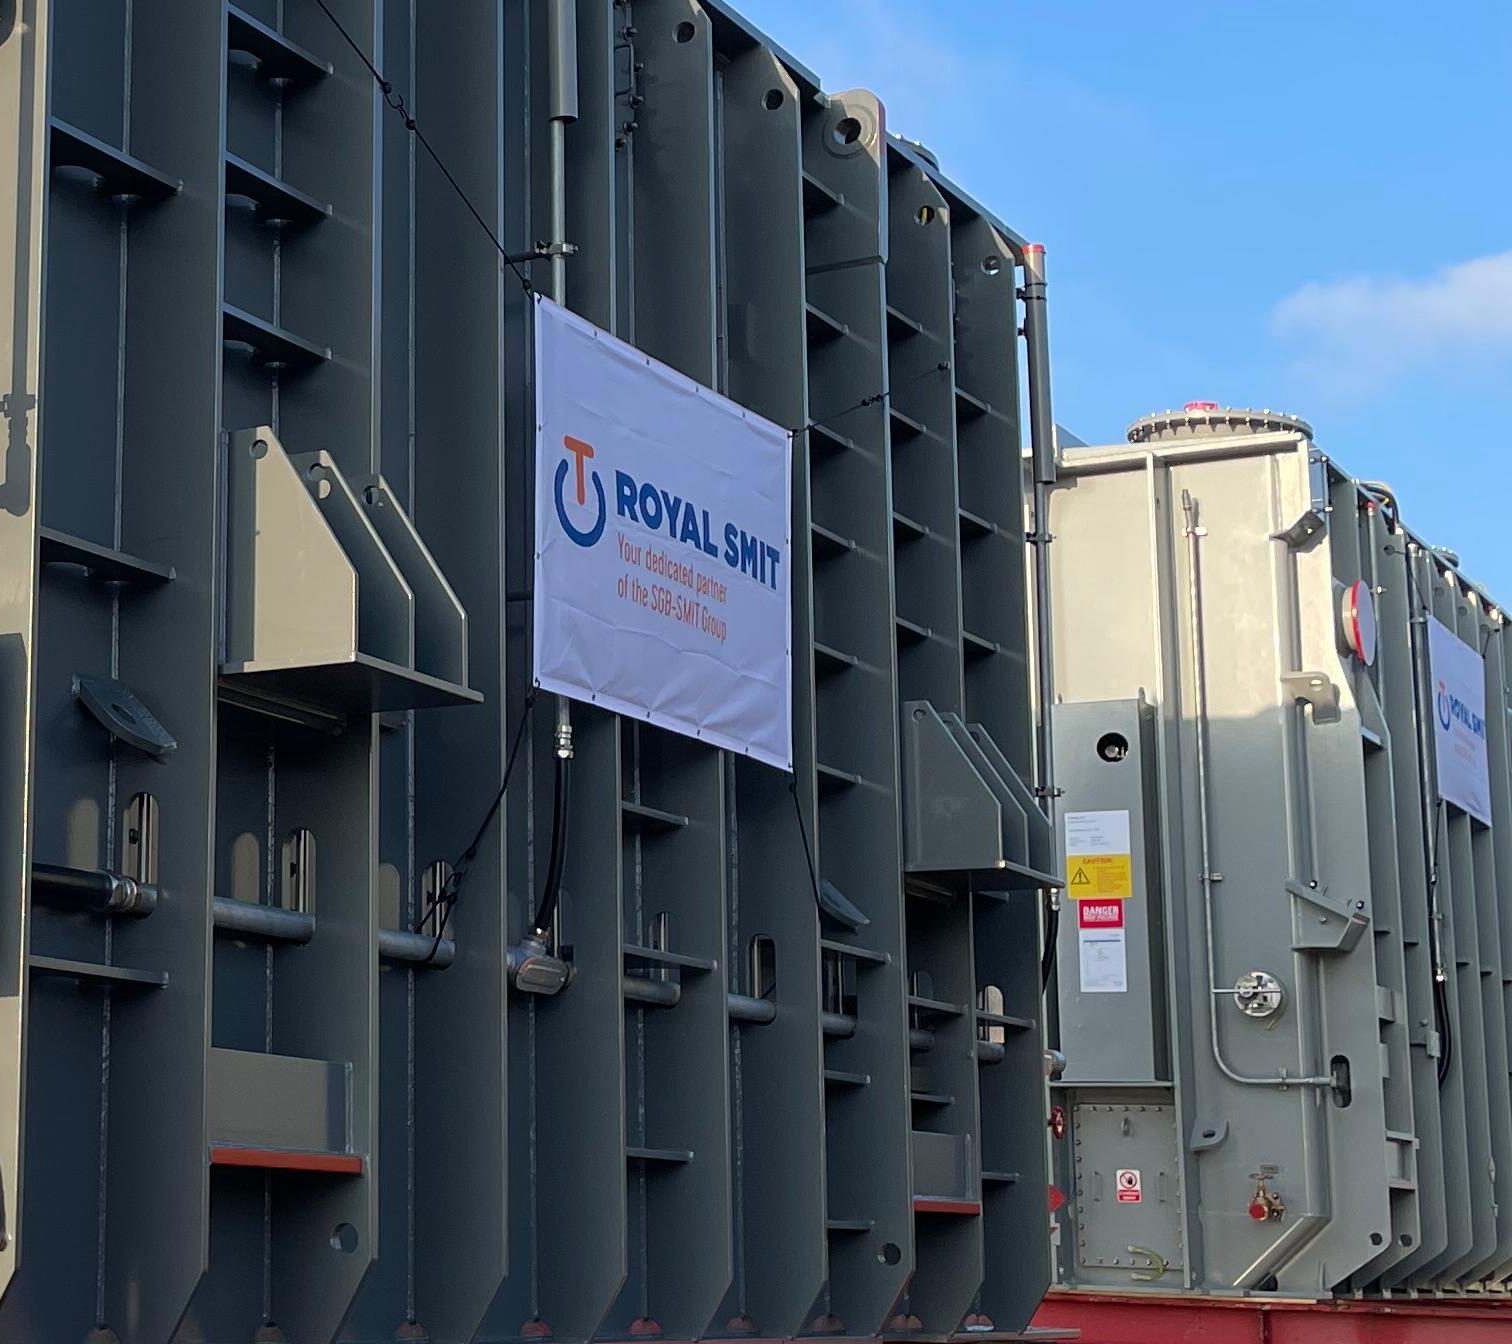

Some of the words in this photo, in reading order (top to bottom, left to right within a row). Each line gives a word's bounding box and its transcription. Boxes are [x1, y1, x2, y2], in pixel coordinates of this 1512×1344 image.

[615, 469, 719, 558] ROYAL
[724, 522, 780, 590] SMIT
[617, 531, 642, 567] Your
[645, 547, 694, 588] dedicated
[696, 571, 728, 605] partner
[617, 574, 629, 599] of
[631, 578, 649, 607] the
[651, 583, 700, 631] SGB-SMIT
[701, 605, 727, 643] Group
[1083, 905, 1119, 915] DANGER
